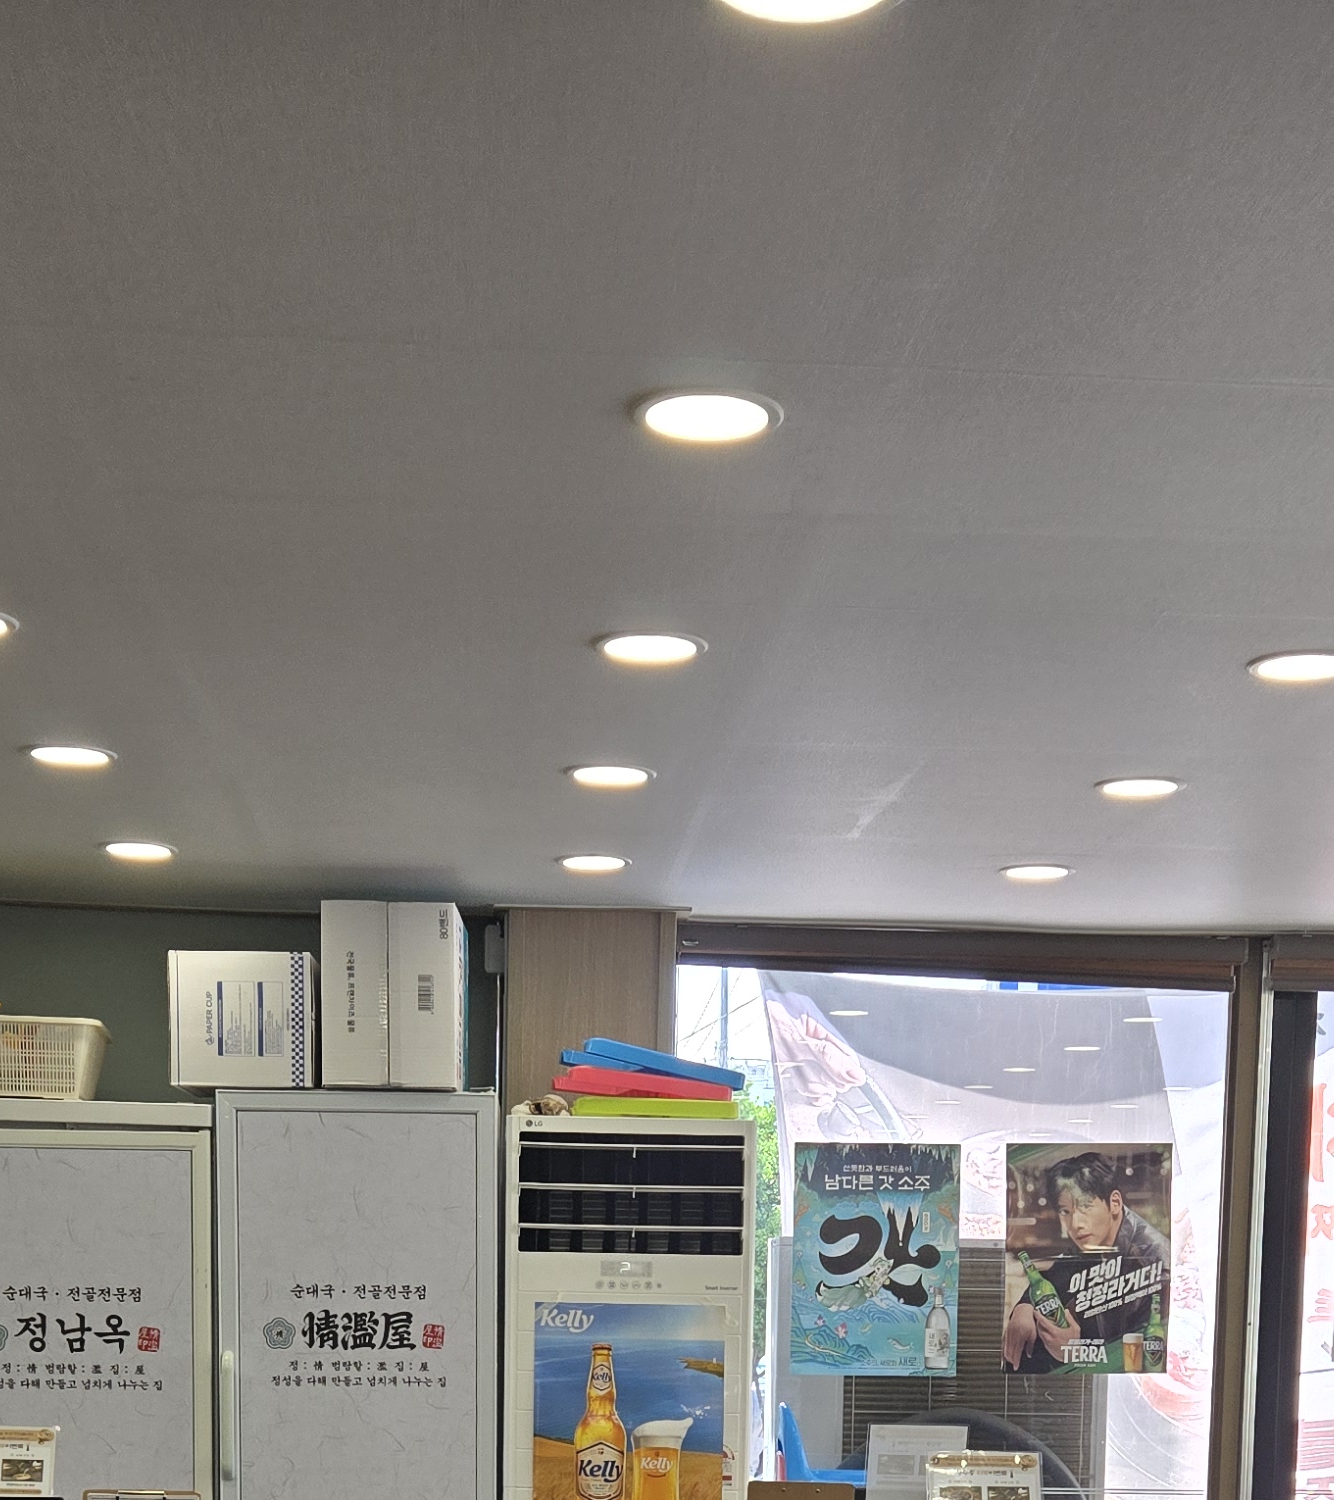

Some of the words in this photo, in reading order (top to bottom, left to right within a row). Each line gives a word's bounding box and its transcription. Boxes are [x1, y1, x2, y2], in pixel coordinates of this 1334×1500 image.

[205, 991, 214, 1004] CUP
[205, 1005, 214, 1034] PAPER
[824, 1174, 875, 1191] 남다른
[879, 1174, 895, 1191] 갓
[898, 1174, 931, 1192] 소주
[1067, 1269, 1087, 1293] 이
[1087, 1256, 1122, 1287] 맛이
[2, 1286, 49, 1301] 순대국
[67, 1286, 142, 1302] 전골전문점
[290, 1283, 335, 1300] 순대국
[353, 1284, 427, 1300] 전골전문점
[1075, 1260, 1163, 1313] 청정라거다!
[1035, 1298, 1062, 1314] TERRA
[540, 1308, 594, 1333] Kelly
[14, 1312, 130, 1354] 정남옥
[301, 1309, 417, 1351] 情濫屋
[1061, 1345, 1108, 1364] TERRA
[1142, 1340, 1164, 1351] TERRA
[20, 1378, 40, 1390] 다해
[45, 1378, 77, 1390] 만들고
[81, 1378, 113, 1390] 넘치게
[117, 1379, 149, 1391] 나누는
[153, 1379, 163, 1391] 집
[271, 1375, 302, 1386] 정성을
[307, 1376, 327, 1387] 다해
[332, 1376, 363, 1387] 만들고
[367, 1376, 398, 1387] 넘치게
[402, 1376, 433, 1388] 나누는
[437, 1377, 447, 1388] 집
[592, 1371, 612, 1383] Kelly
[578, 1459, 624, 1483] Kelly
[640, 1456, 673, 1474] Kelly
